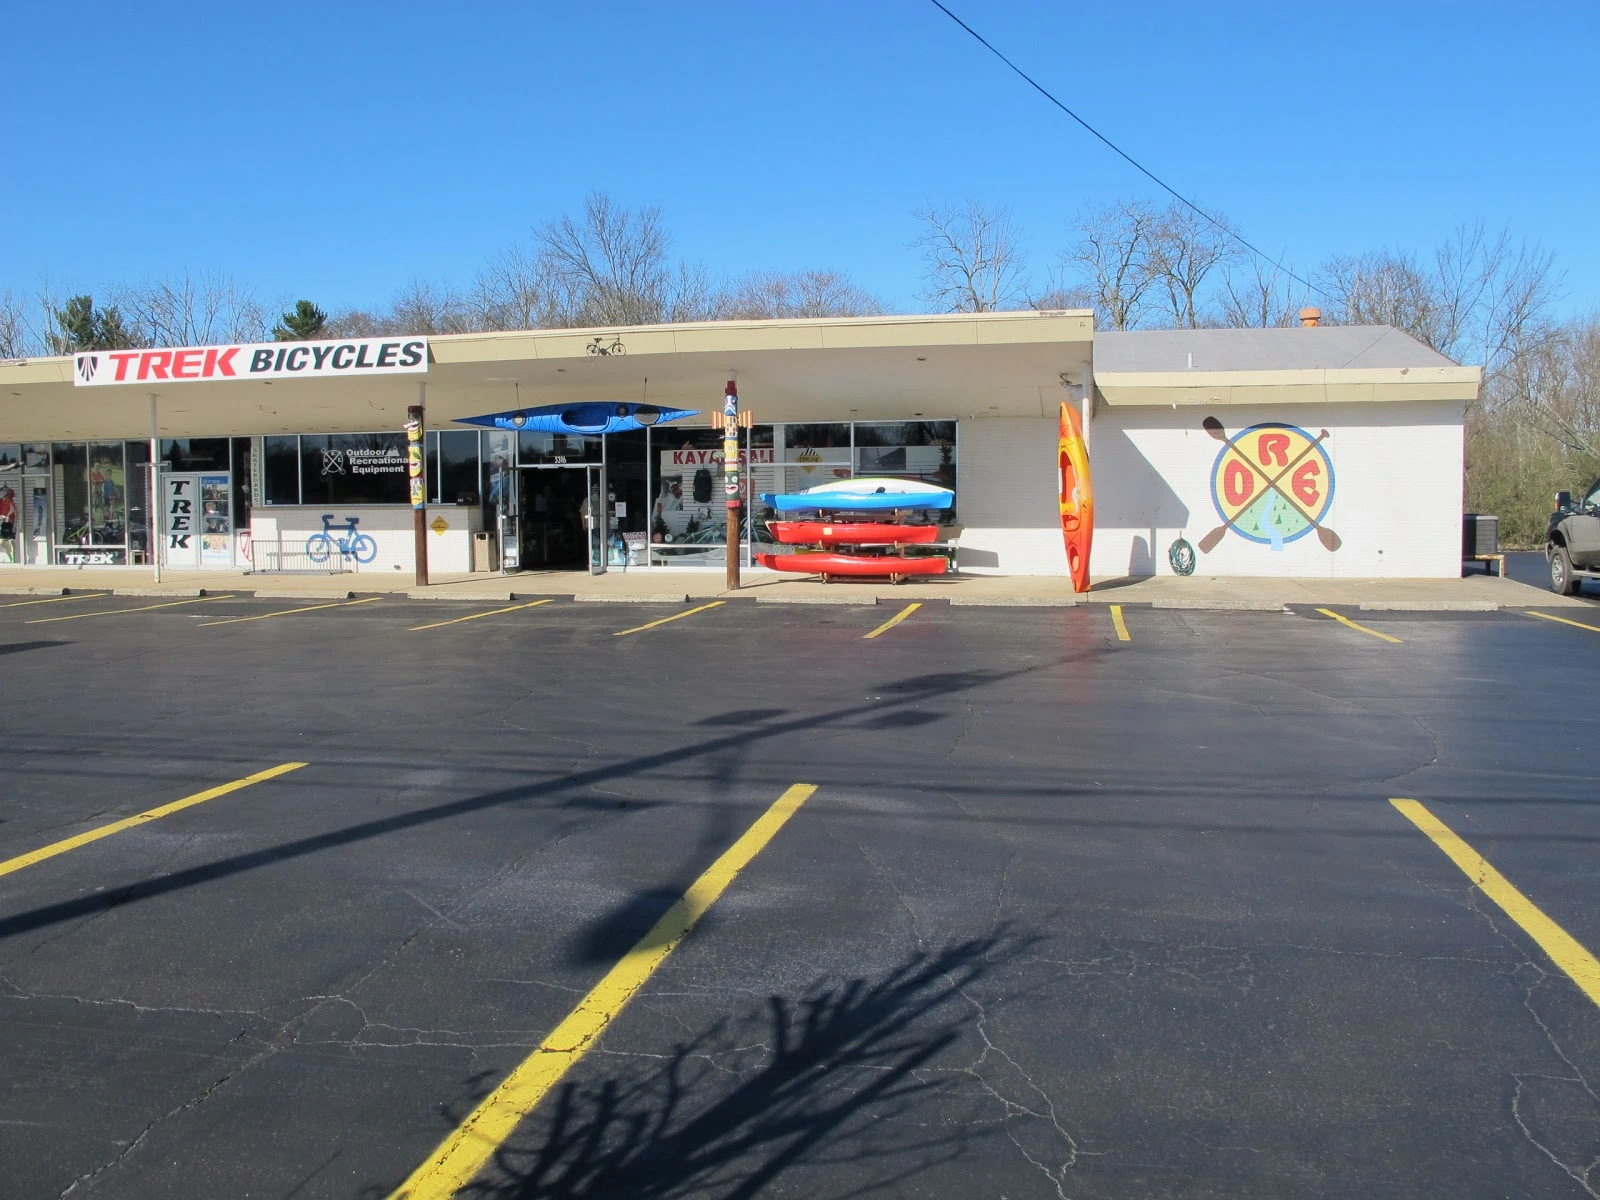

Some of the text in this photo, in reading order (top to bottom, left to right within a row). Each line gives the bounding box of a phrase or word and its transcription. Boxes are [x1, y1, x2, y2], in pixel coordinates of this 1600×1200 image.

[108, 341, 425, 382] TREK BICYCLES
[346, 449, 387, 457] Outdoor
[673, 450, 726, 465] KAYA
[349, 456, 410, 465] Recreationa
[352, 465, 405, 475] Equipment
[170, 480, 192, 549] TREK
[65, 554, 114, 565] TREK
